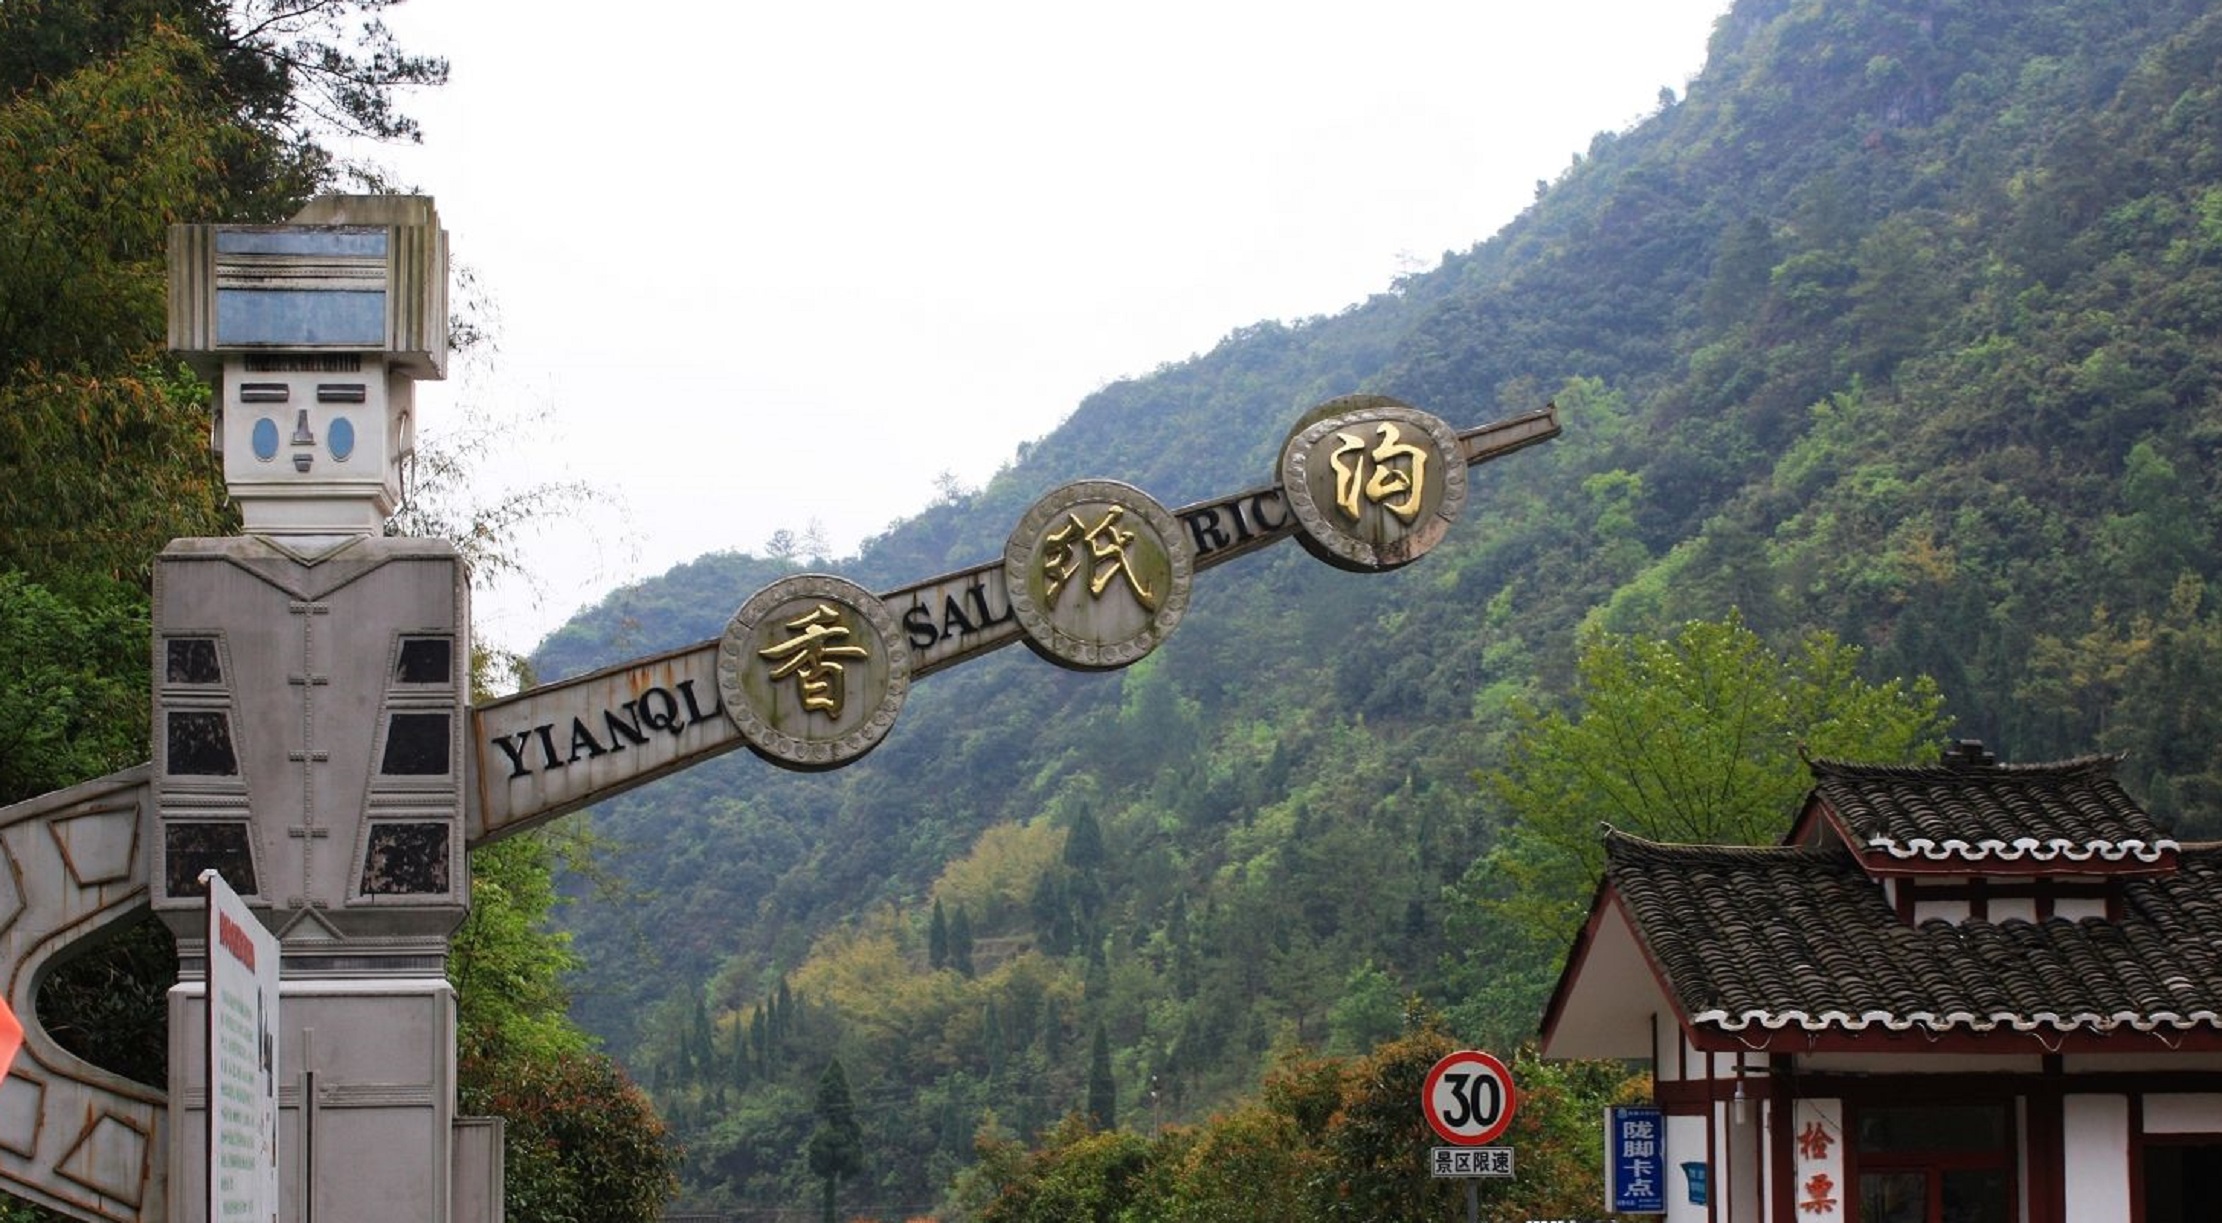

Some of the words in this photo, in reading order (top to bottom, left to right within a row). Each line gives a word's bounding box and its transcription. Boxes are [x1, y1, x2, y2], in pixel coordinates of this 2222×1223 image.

[758, 604, 869, 721] 香
[1330, 421, 1428, 521] 沟
[902, 583, 1013, 652] SAL
[1184, 487, 1288, 556] RIC
[1443, 1073, 1501, 1128] 30
[1435, 1151, 1509, 1174] 景区限速
[1622, 1120, 1655, 1198] 陇脚卡点
